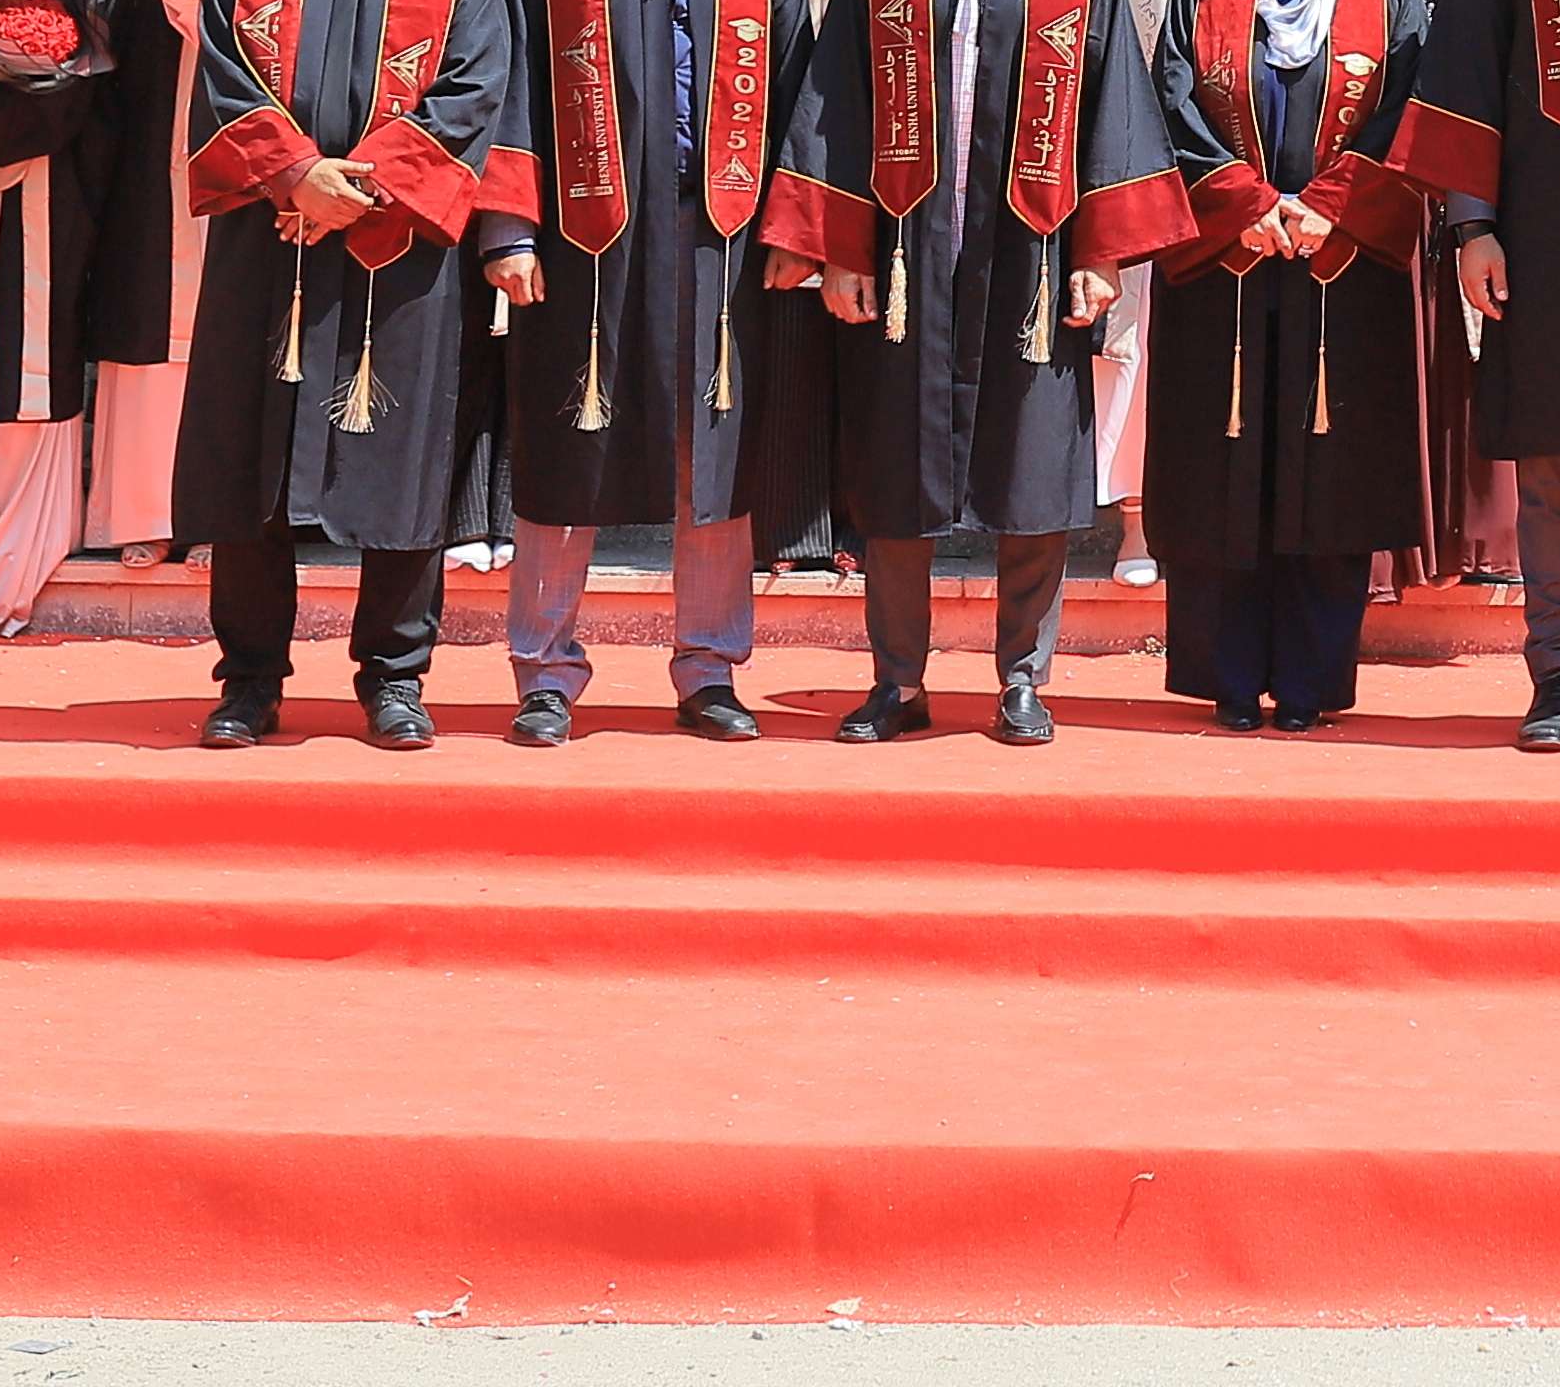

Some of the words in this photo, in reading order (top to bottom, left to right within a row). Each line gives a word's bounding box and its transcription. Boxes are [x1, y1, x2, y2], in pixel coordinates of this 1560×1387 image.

[726, 47, 758, 151] 2025
[905, 48, 920, 110] UNIVERSITY
[592, 84, 608, 148] UNIVERSITY
[908, 111, 921, 147] BENHA
[596, 149, 611, 185] BENHA
